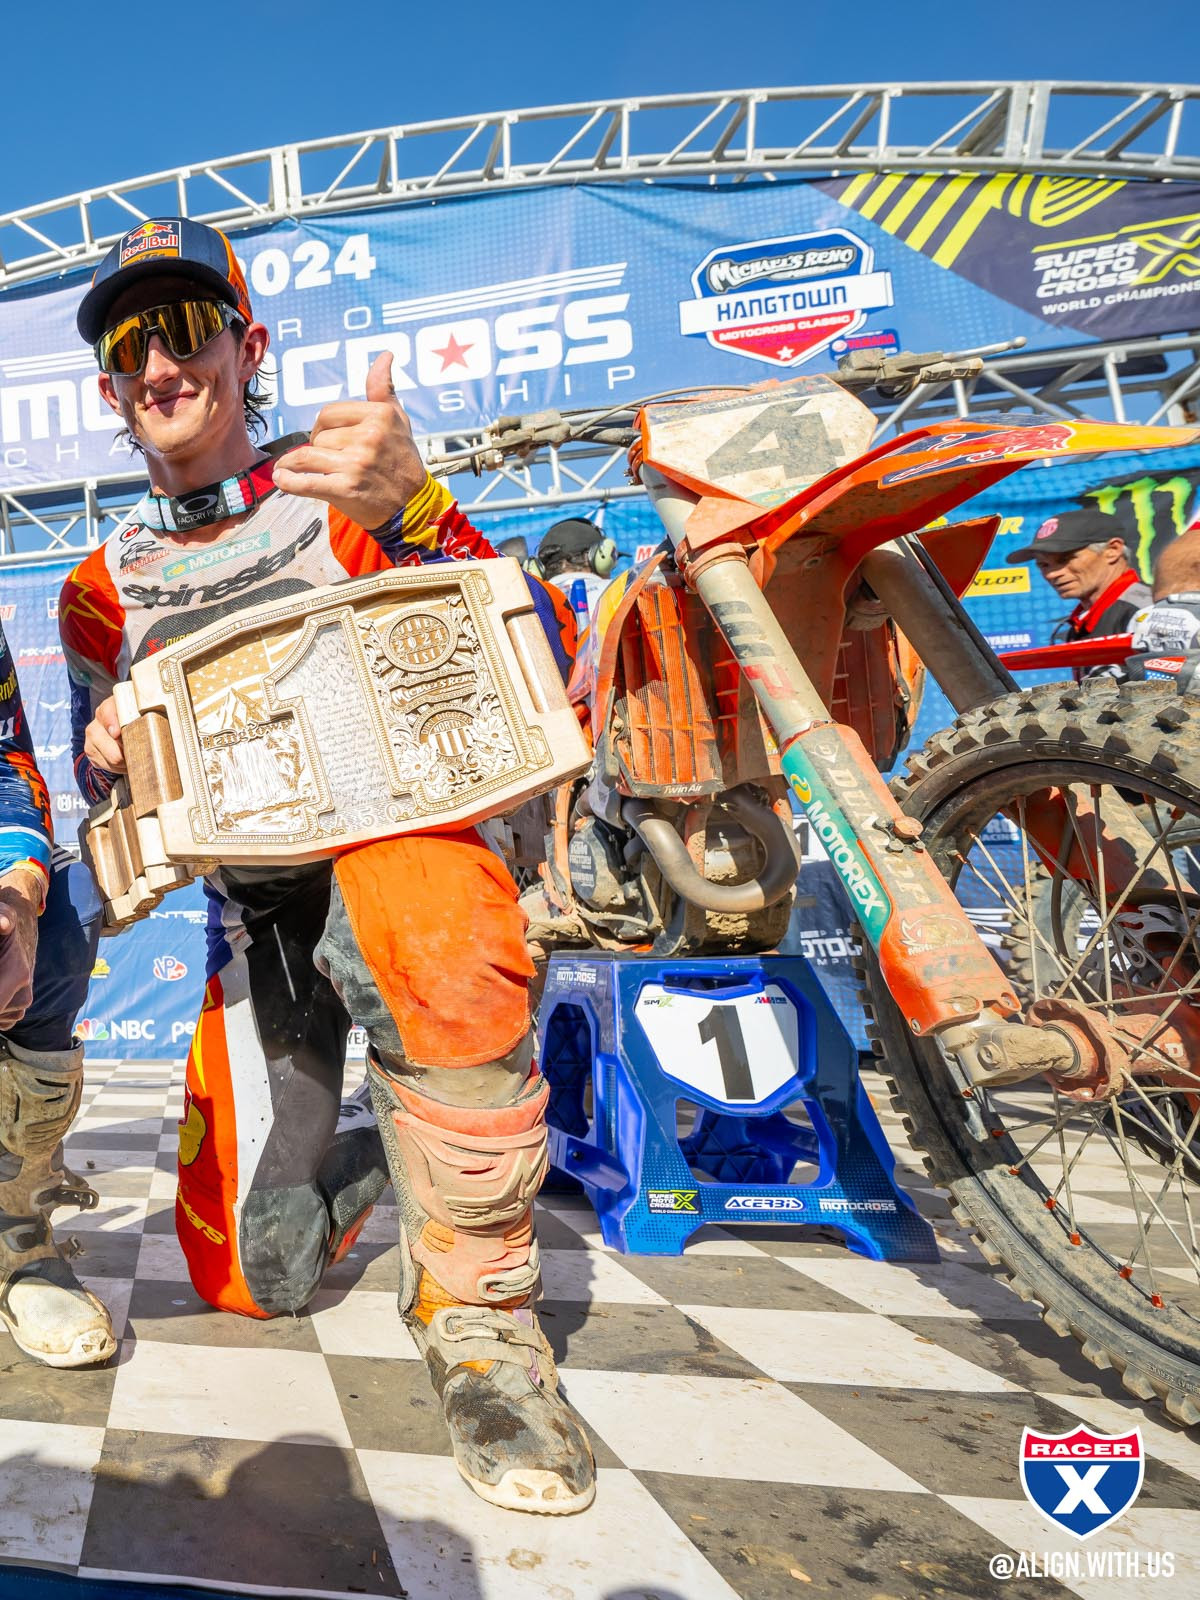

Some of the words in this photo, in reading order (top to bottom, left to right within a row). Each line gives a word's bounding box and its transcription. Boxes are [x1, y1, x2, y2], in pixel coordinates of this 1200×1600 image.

[121, 237, 148, 261] Red
[149, 234, 178, 248] Bull
[804, 247, 855, 268] RENO
[1033, 241, 1139, 272] SUPER
[1036, 268, 1140, 298] CROSS
[1041, 256, 1136, 284] MOTO
[717, 285, 848, 322] HANGTOWN
[1042, 298, 1101, 315] WORLD
[719, 321, 796, 342] MOTOCROSS
[797, 314, 851, 330] CLASSIC
[705, 398, 848, 481] 4
[177, 511, 207, 525] FACTORY
[188, 536, 262, 571] MOTOREX
[973, 574, 1024, 587] NLOP
[397, 617, 438, 635] JUNE
[393, 631, 444, 653] 2024
[434, 720, 461, 733] NORTH
[333, 804, 402, 831] 450
[806, 799, 885, 918] MOTOREX
[111, 1019, 155, 1040] NBC
[697, 1004, 756, 1100] 1
[818, 1200, 897, 1212] MOTOCROSS
